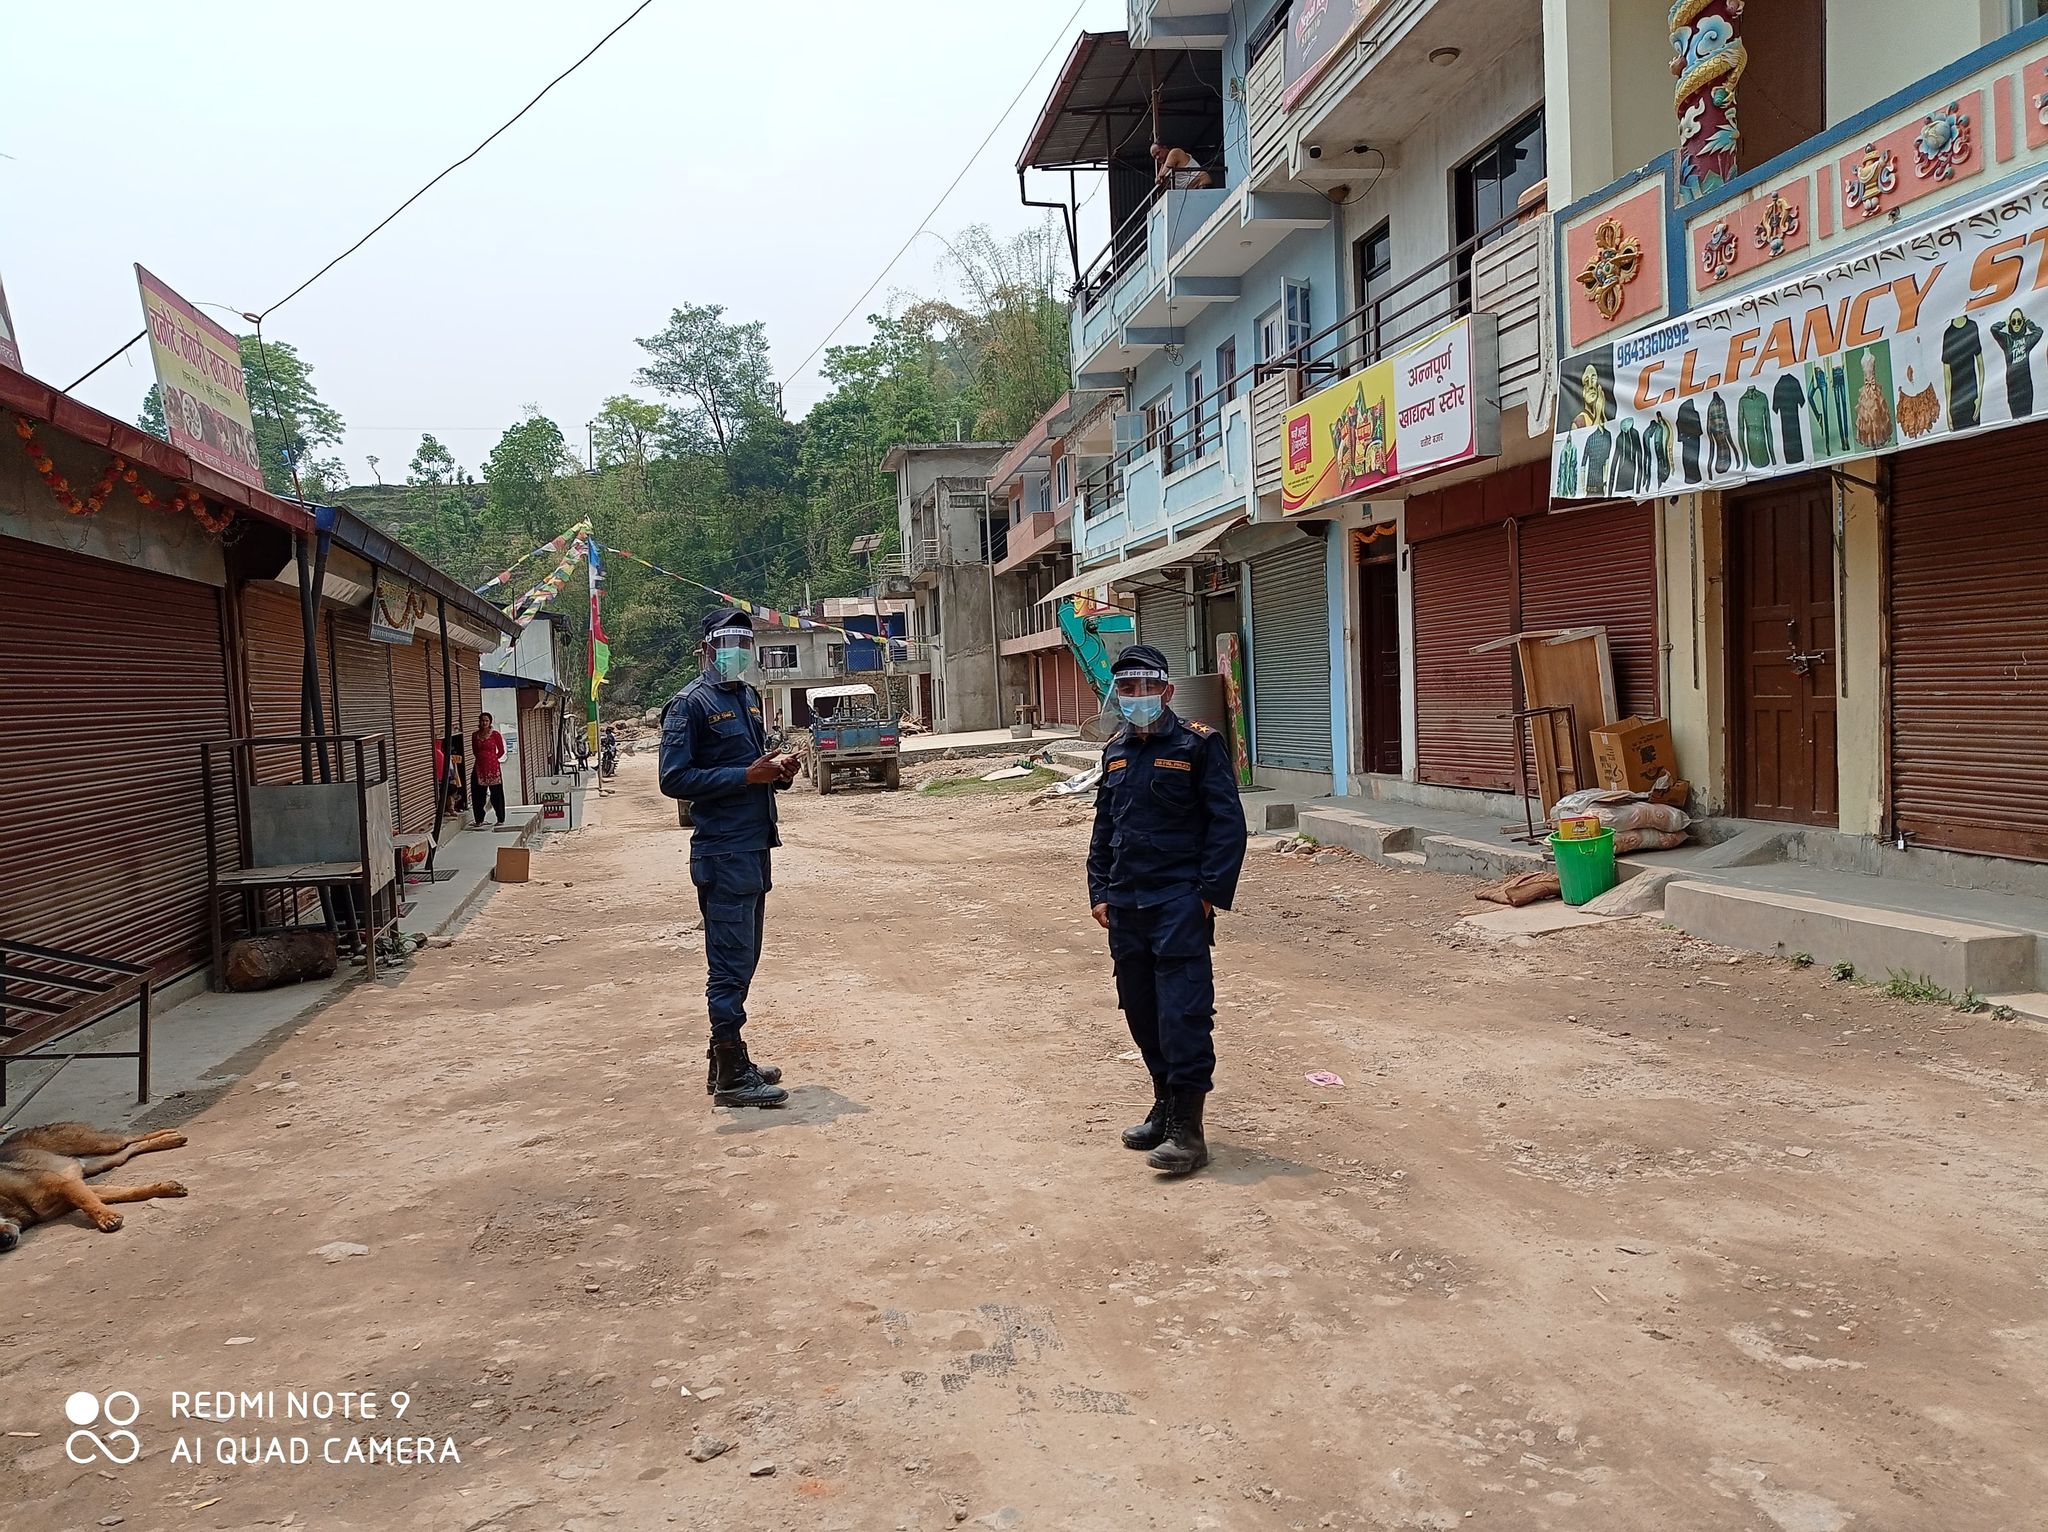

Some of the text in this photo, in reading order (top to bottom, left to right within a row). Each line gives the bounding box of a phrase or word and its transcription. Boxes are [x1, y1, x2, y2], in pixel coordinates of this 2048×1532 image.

[1407, 342, 1453, 388] अन्नपूर्ण
[1617, 321, 1690, 368] 9843360892
[206, 348, 232, 391] खाजा
[230, 364, 247, 401] घर
[1438, 382, 1465, 413] स्टोर
